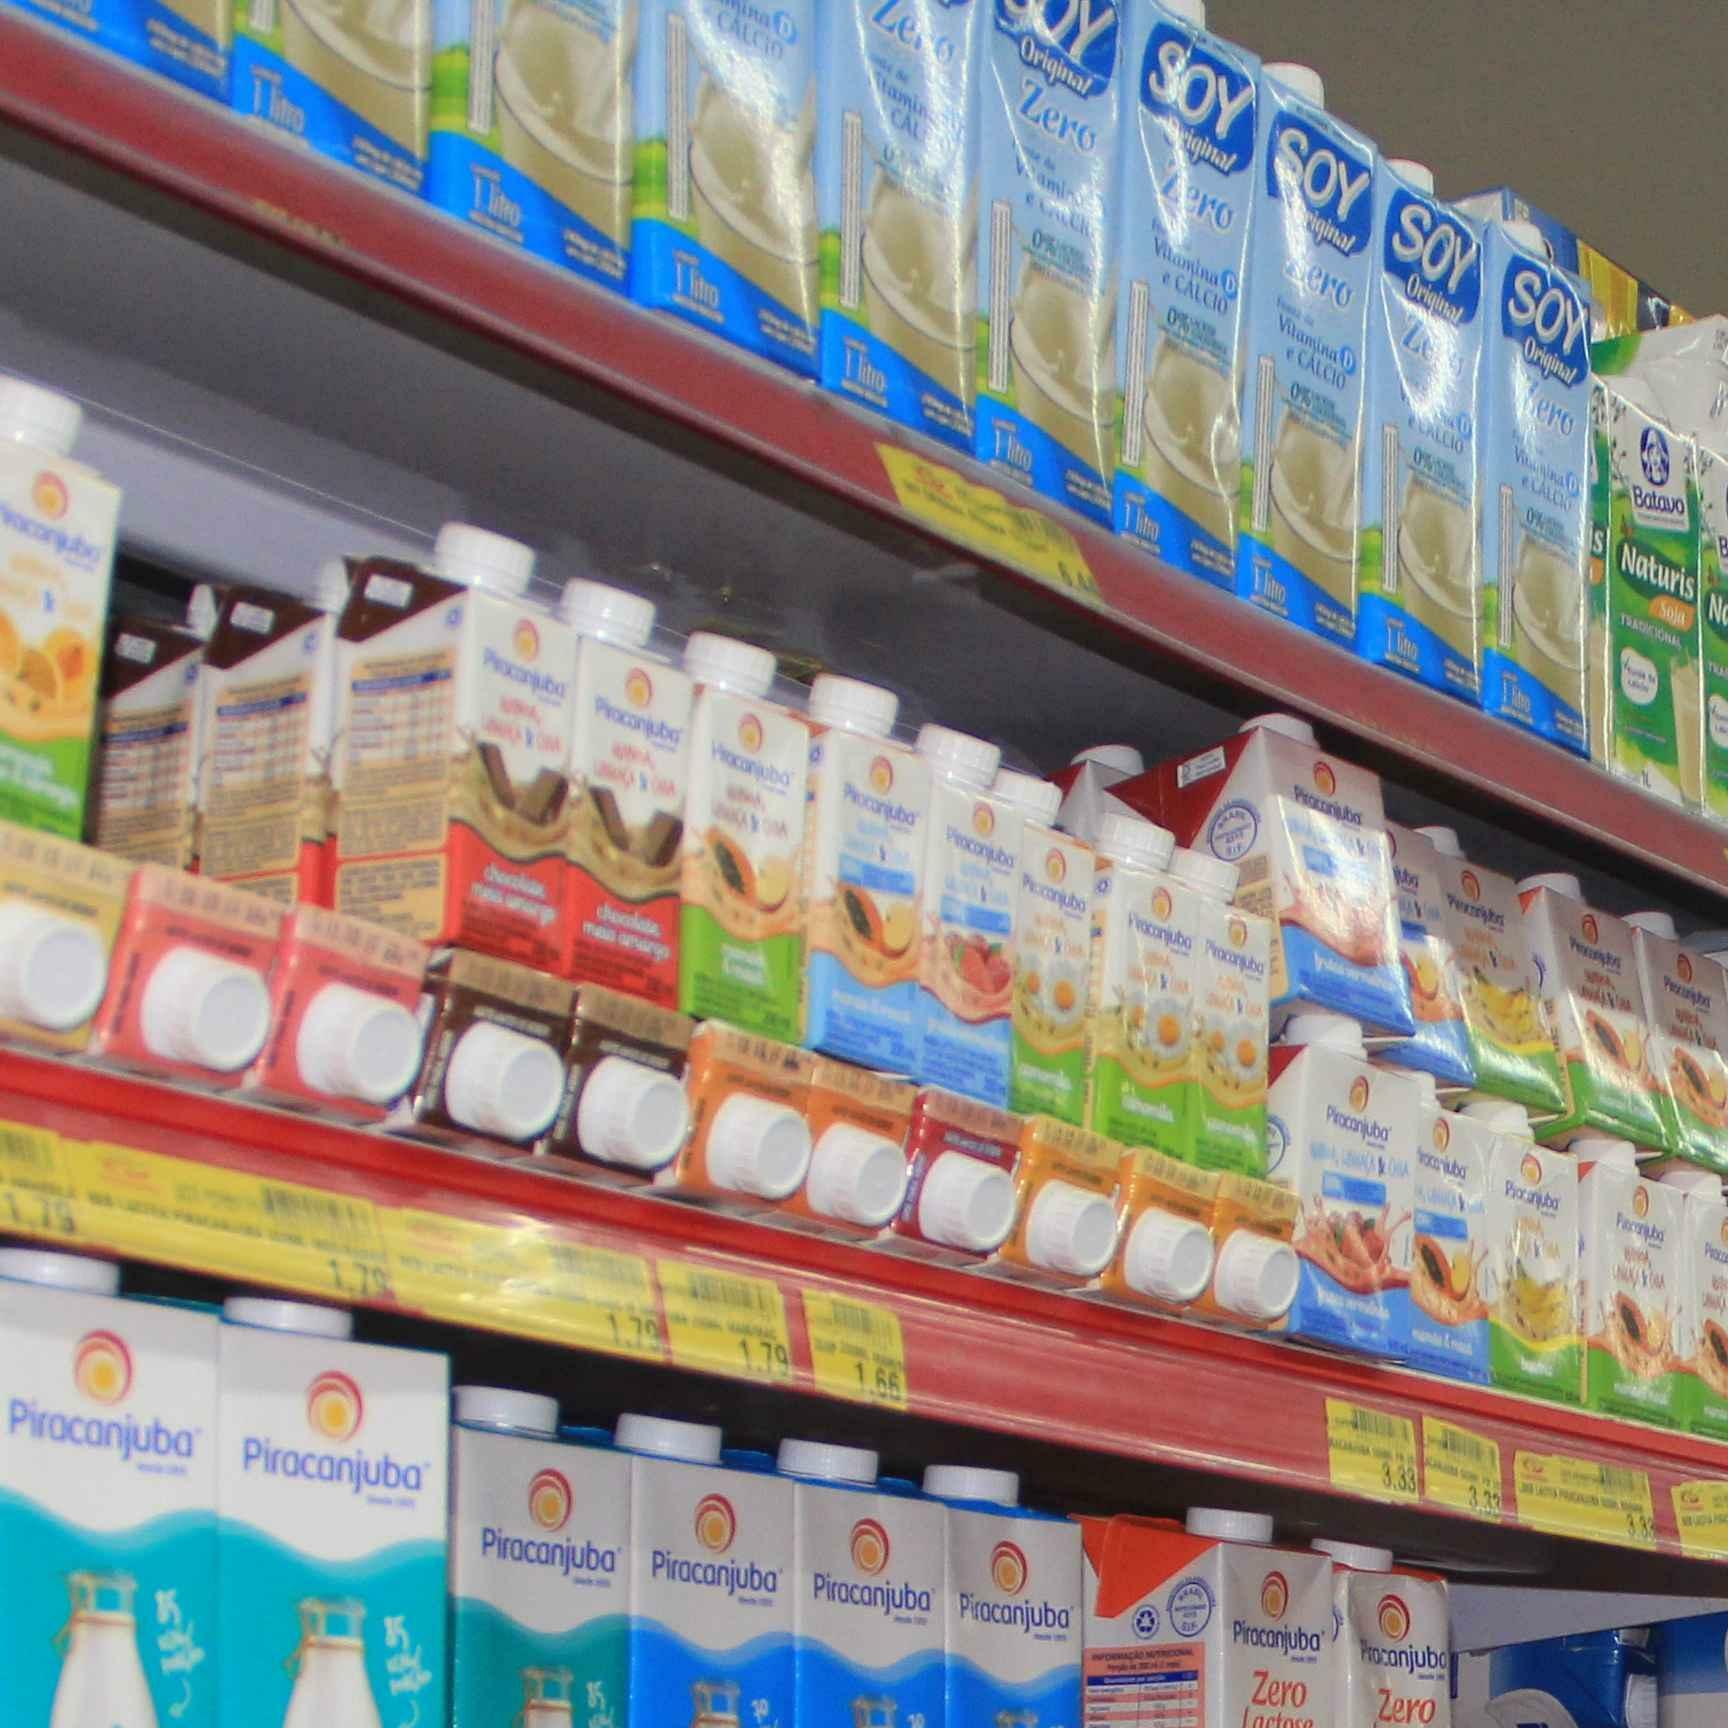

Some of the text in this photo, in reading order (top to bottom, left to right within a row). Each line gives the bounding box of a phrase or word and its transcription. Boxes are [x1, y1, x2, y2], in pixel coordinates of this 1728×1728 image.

[1018, 36, 1094, 99] Original
[1148, 40, 1254, 140] SOY
[1018, 76, 1098, 153] Zero
[1278, 125, 1371, 222] SOY
[1391, 202, 1478, 292] SOY
[1404, 272, 1466, 326] Original
[1508, 270, 1584, 352] SOY
[1522, 336, 1580, 390] Original
[1632, 485, 1685, 517] Batavo
[1620, 541, 1696, 600] Naturis
[1658, 601, 1689, 628] Soja
[483, 647, 566, 698] Piracanjuba
[595, 696, 683, 744] Piracanjuba
[1293, 785, 1362, 825] Piracanjuba
[1205, 937, 1264, 975] Piracanjuba
[738, 1337, 790, 1377] 1.79
[854, 1361, 902, 1402] 1.66
[8, 1398, 195, 1463] Piracanjuba
[242, 1437, 424, 1495] Piracanjuba
[1381, 1461, 1418, 1494] 3.33
[480, 1526, 617, 1581] Piracanjuba
[651, 1549, 779, 1598] Piracanjuba
[813, 1571, 932, 1615] Piracanjuba
[959, 1592, 1073, 1637] Piracanjuba
[1232, 1618, 1322, 1656] Piracanjuba
[1358, 1642, 1447, 1676] Piracanjuba
[1249, 1668, 1307, 1709] Zero
[1376, 1688, 1437, 1724] Zero
